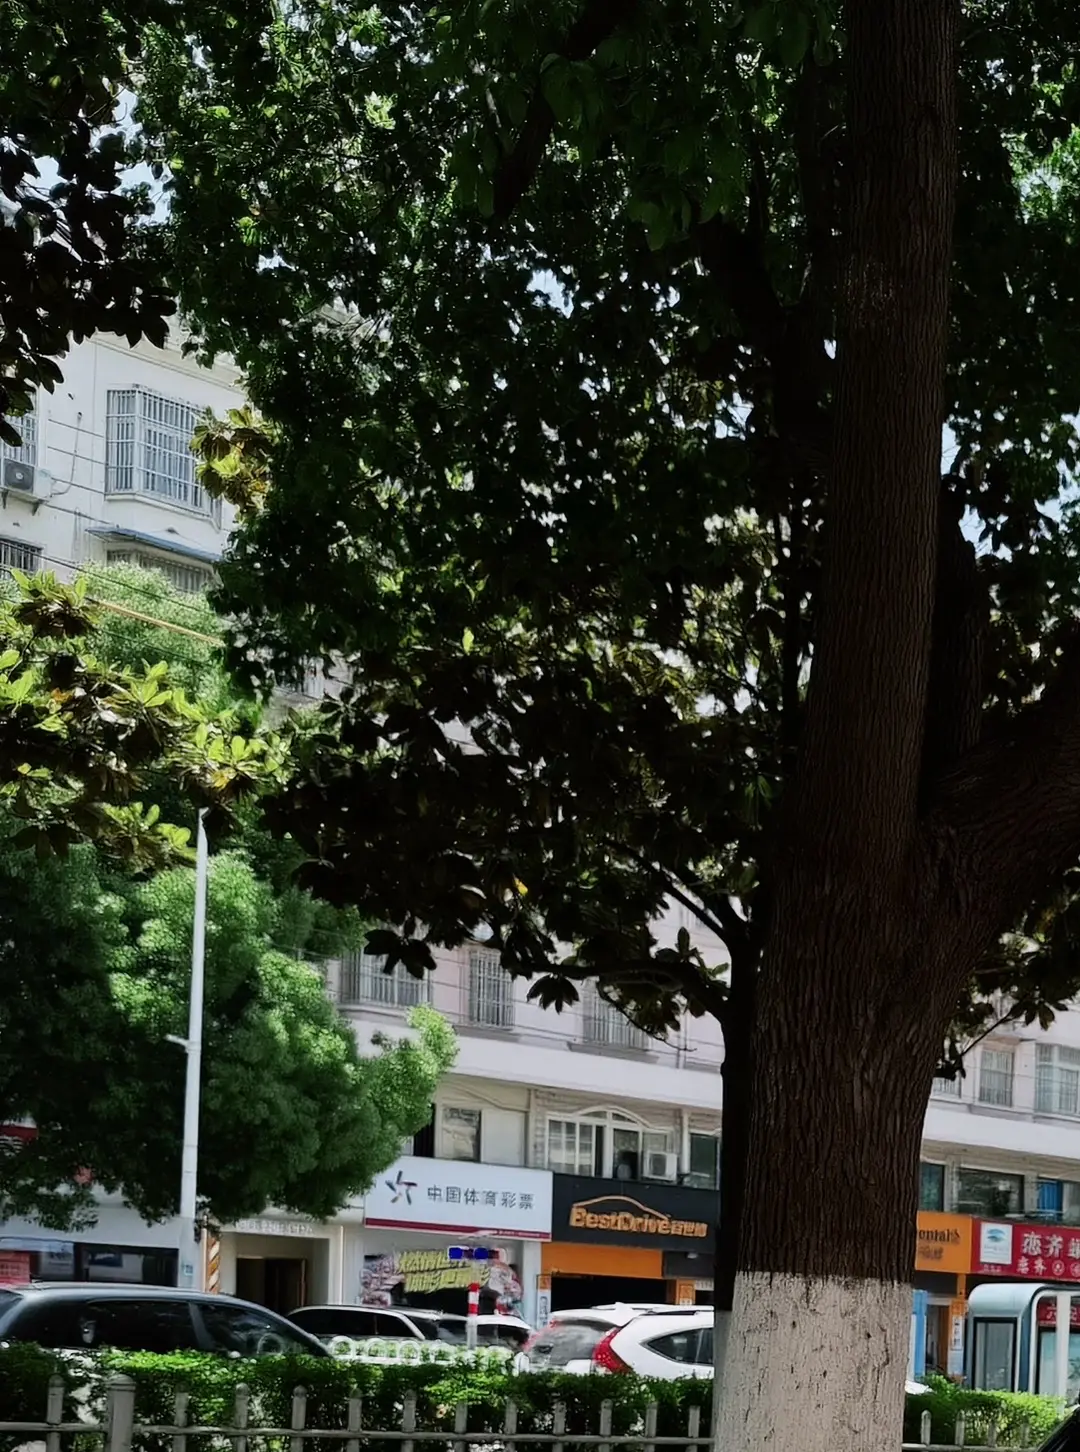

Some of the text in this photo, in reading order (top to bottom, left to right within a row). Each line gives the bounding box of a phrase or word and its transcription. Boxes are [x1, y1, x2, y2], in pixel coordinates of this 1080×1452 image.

[427, 1184, 534, 1210] 中国体育彩票
[569, 1207, 671, 1235] BestDrive
